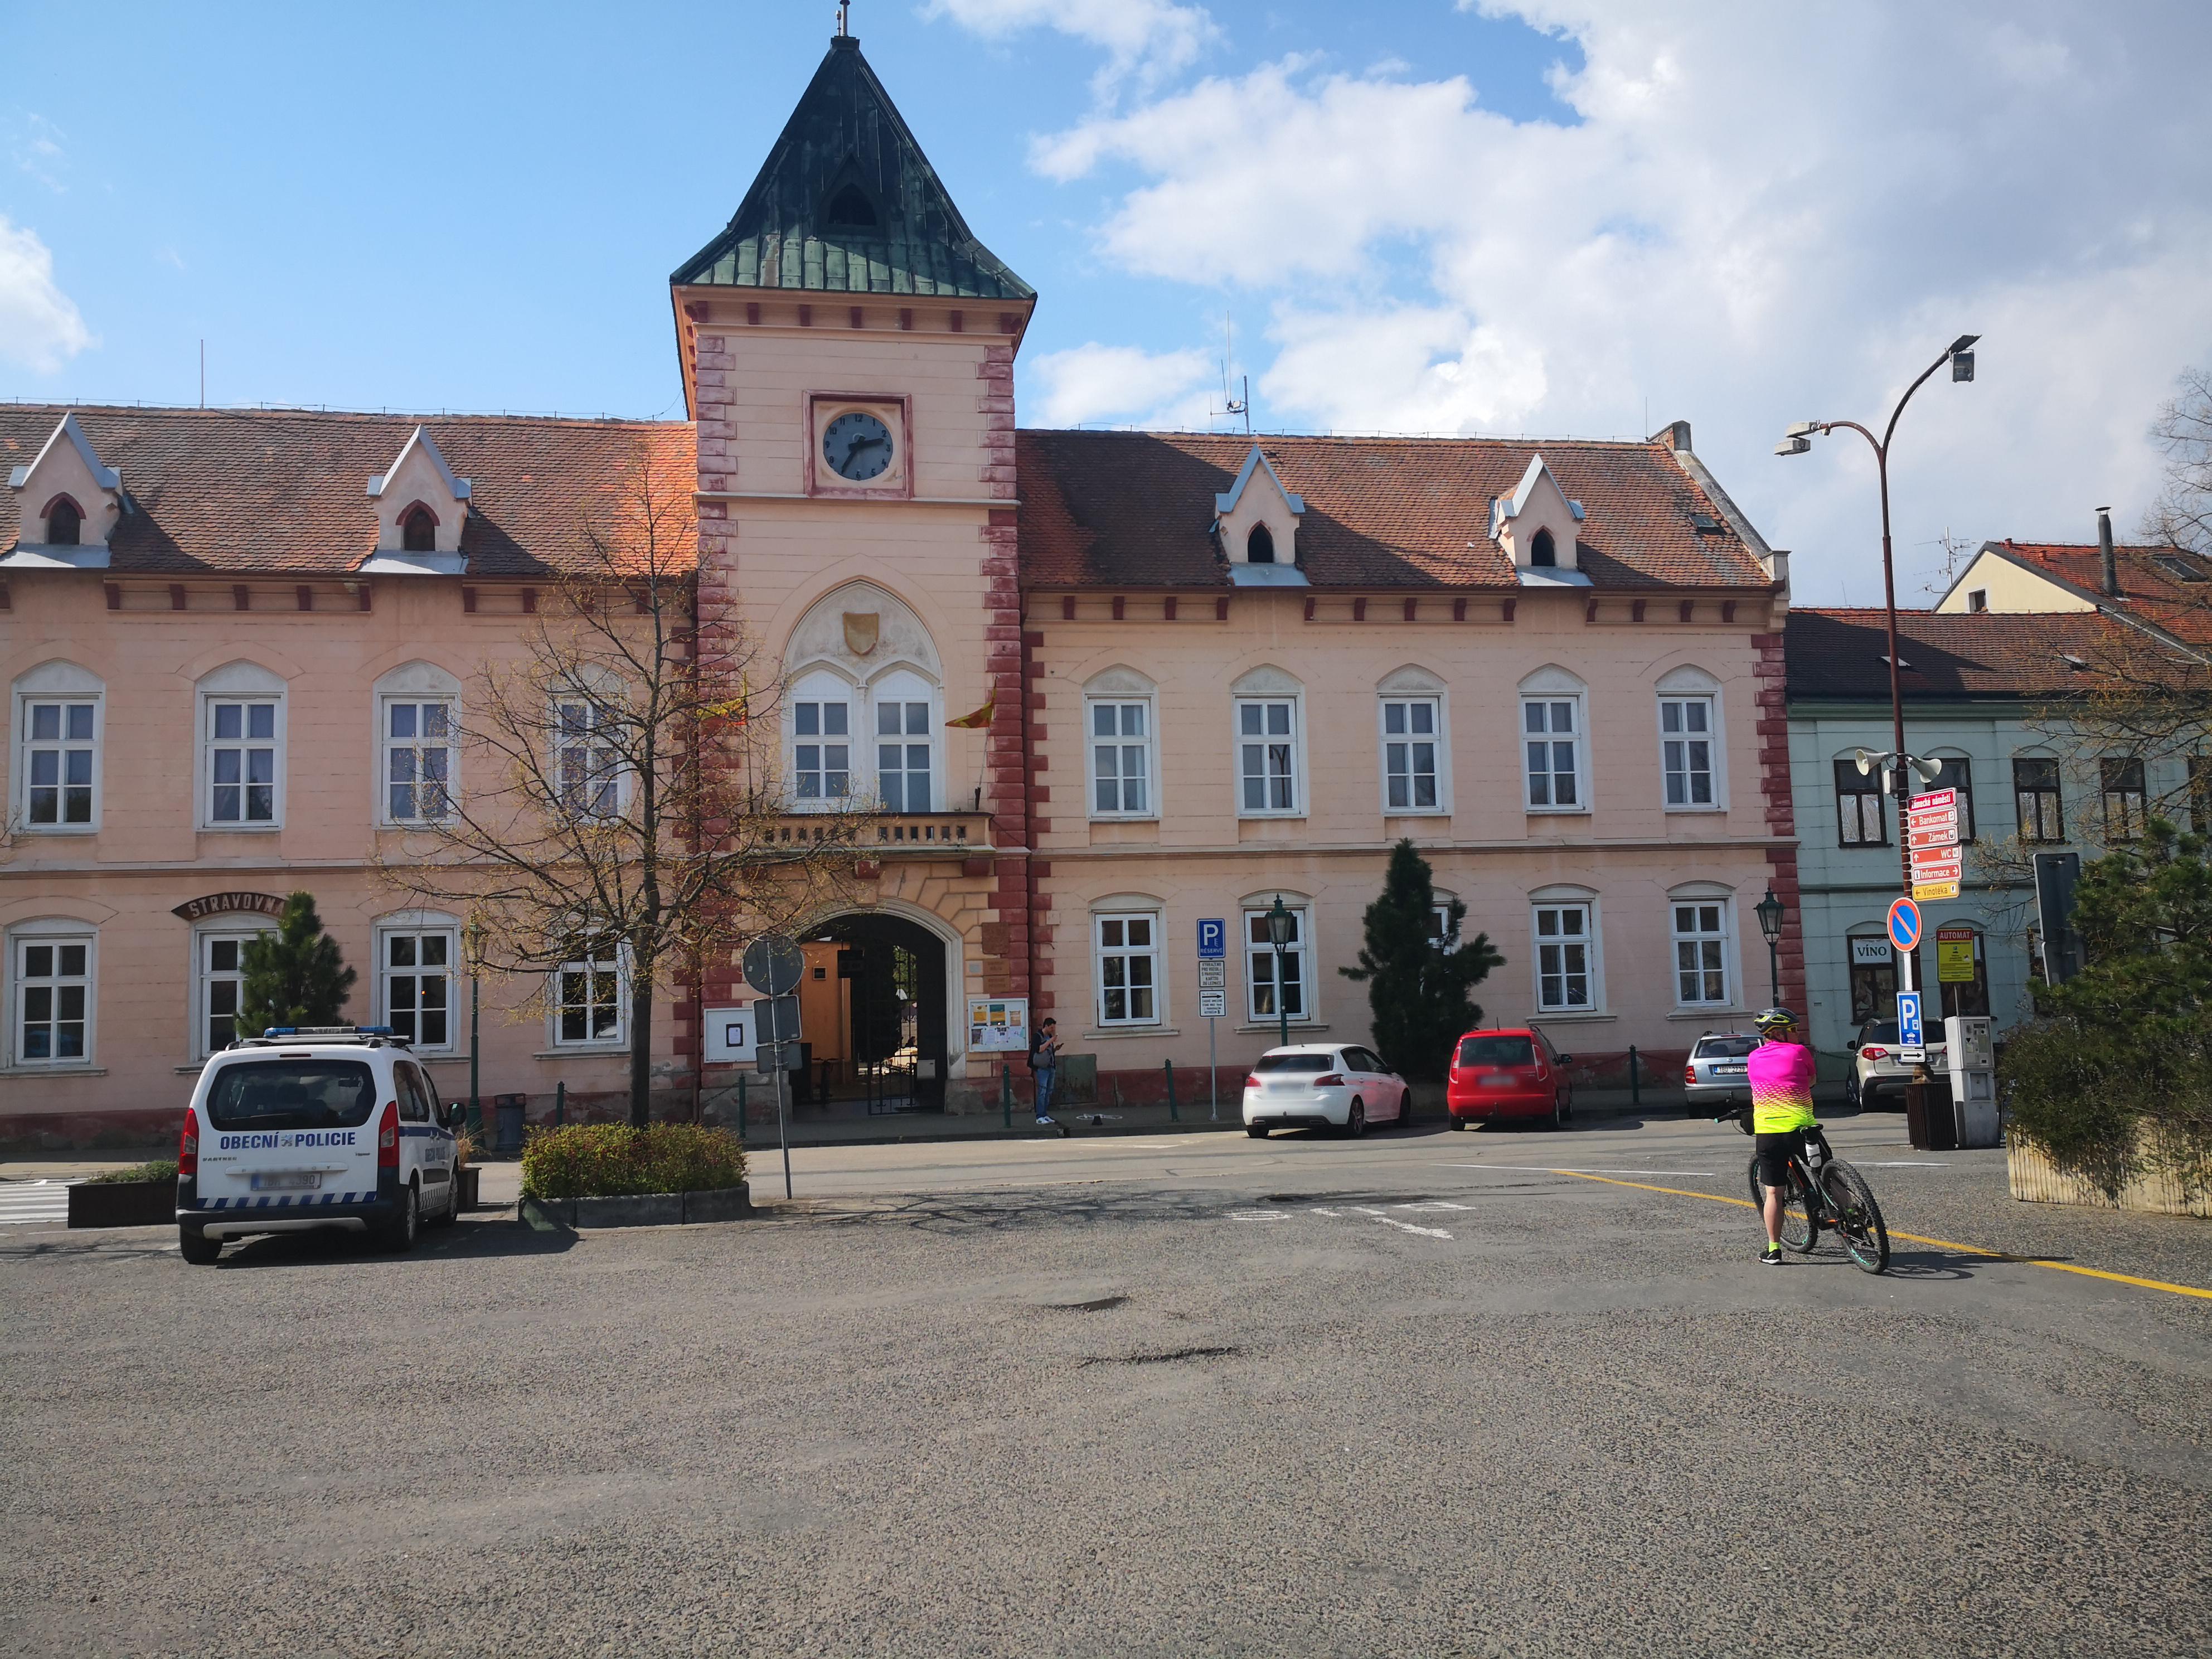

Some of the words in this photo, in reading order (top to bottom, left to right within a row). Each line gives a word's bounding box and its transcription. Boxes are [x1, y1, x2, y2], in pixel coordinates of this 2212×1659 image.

[872, 418, 876, 426] 1
[830, 426, 837, 435] 10
[881, 429, 886, 438] 2
[870, 468, 876, 477] 5
[1932, 793, 1951, 805] náměstí
[1919, 813, 1947, 825] Bankomat
[1928, 831, 1948, 842] Zámek
[1941, 848, 1952, 858] WC
[1920, 869, 1950, 879] Informace
[1923, 886, 1948, 896] Vinotéka
[188, 894, 285, 918] STRAVOVNA
[1204, 924, 1219, 946] P
[1857, 944, 1887, 956] VÍNO
[1901, 999, 1915, 1030] P
[220, 1132, 279, 1149] OBECNÍ
[295, 1132, 356, 1147] POLICIE
